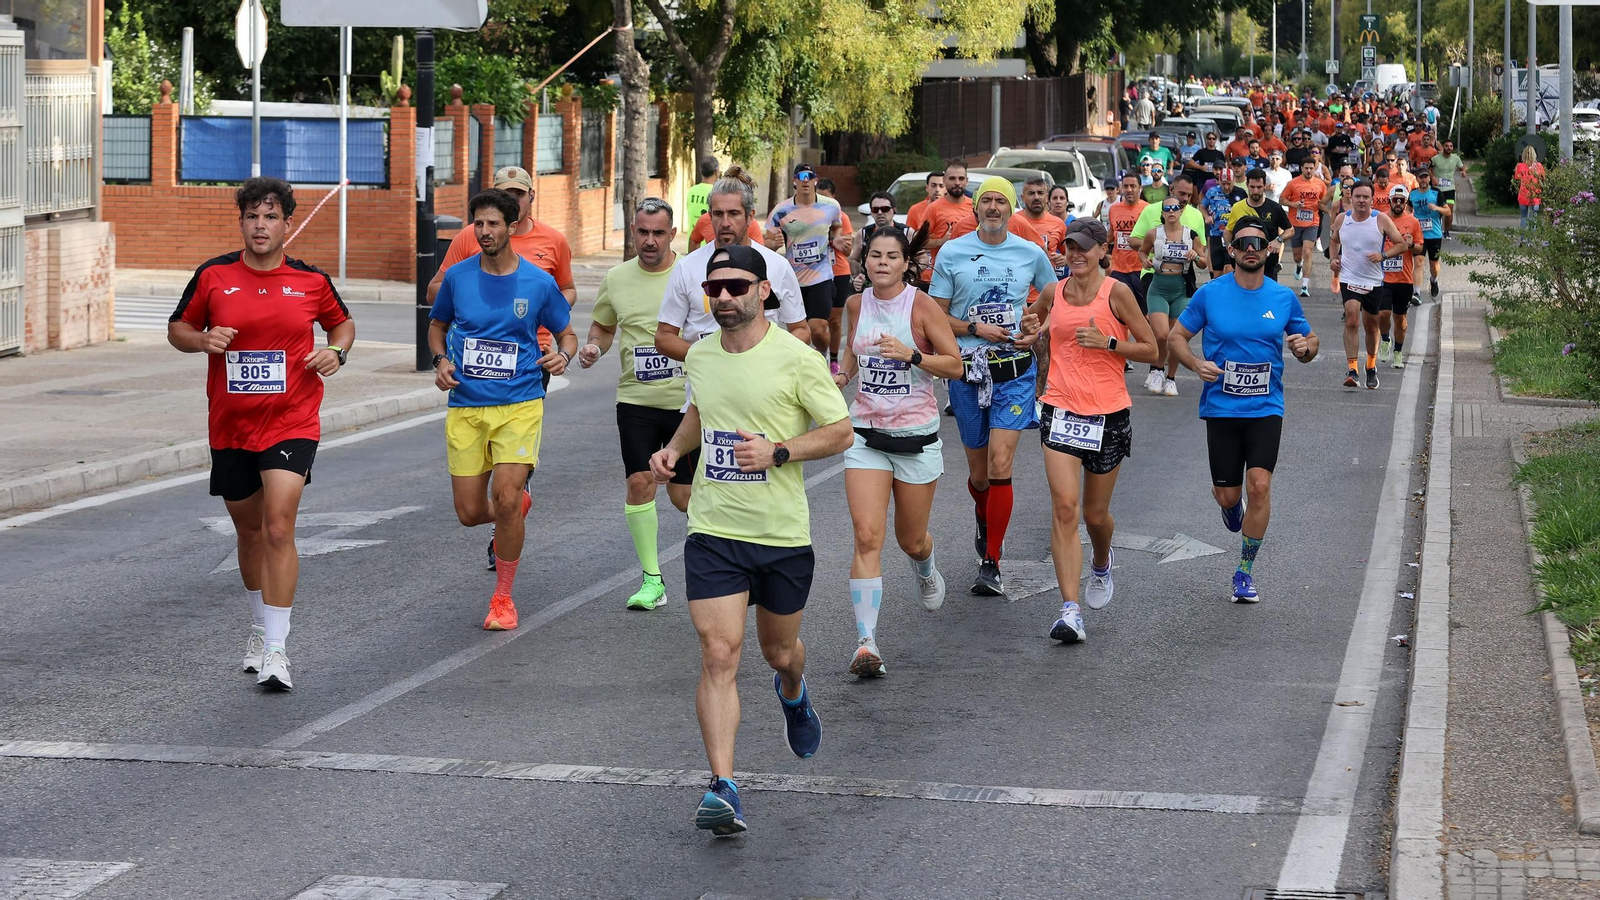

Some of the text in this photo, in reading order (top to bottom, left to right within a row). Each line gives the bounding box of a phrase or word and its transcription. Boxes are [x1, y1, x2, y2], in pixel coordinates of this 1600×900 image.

[691, 194, 708, 204] STA
[798, 249, 812, 257] 691
[980, 314, 1004, 325] 958
[475, 352, 503, 367] 606
[645, 357, 669, 370] 609
[240, 365, 271, 380] 805
[870, 369, 898, 385] 772
[1235, 373, 1259, 385] 706
[1064, 422, 1091, 438] 959
[715, 447, 735, 466] 81
